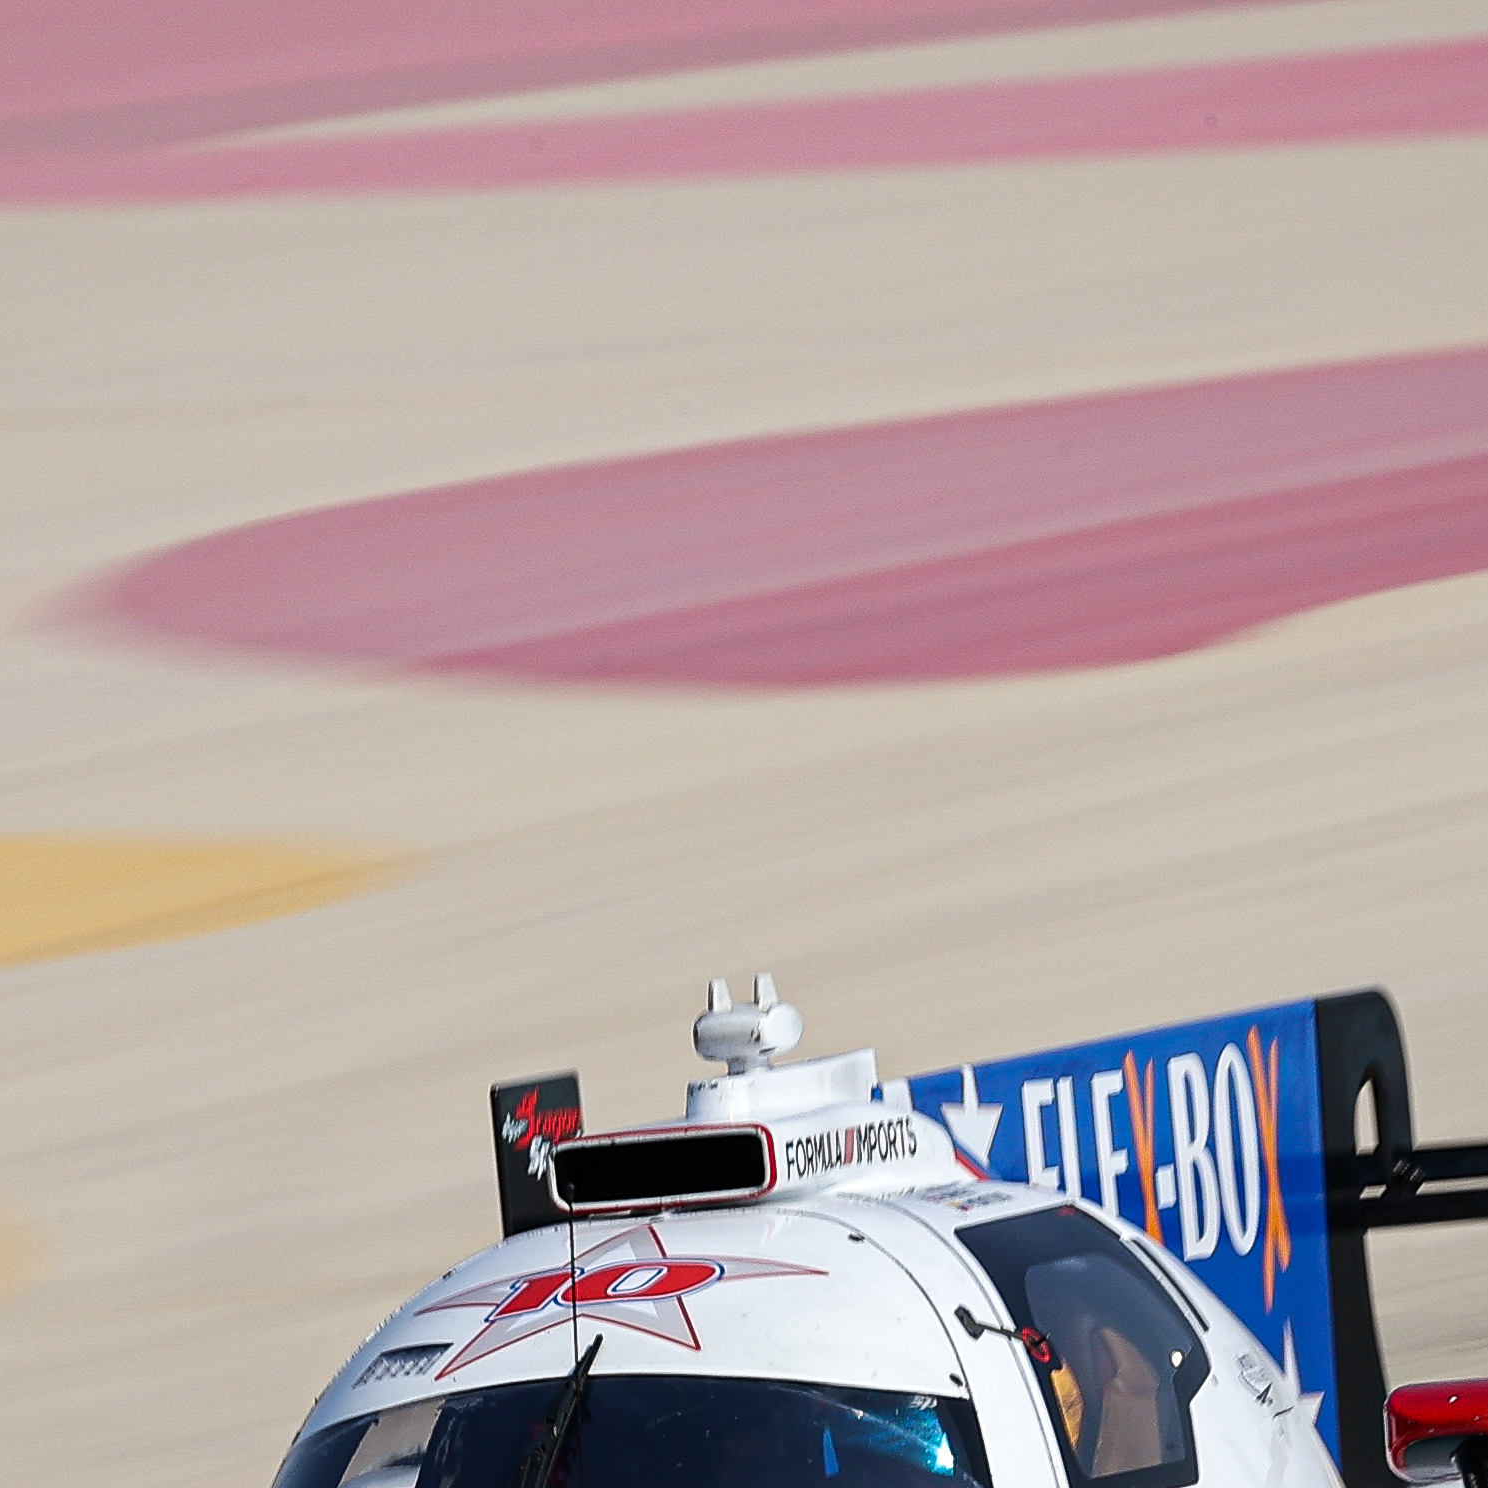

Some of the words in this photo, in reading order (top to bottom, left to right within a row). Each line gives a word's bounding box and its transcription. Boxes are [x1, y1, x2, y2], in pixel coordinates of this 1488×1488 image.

[785, 1129, 843, 1181] FORMULA
[1022, 1023, 1291, 1315] FLEX-BOX
[484, 1258, 726, 1323] 10
